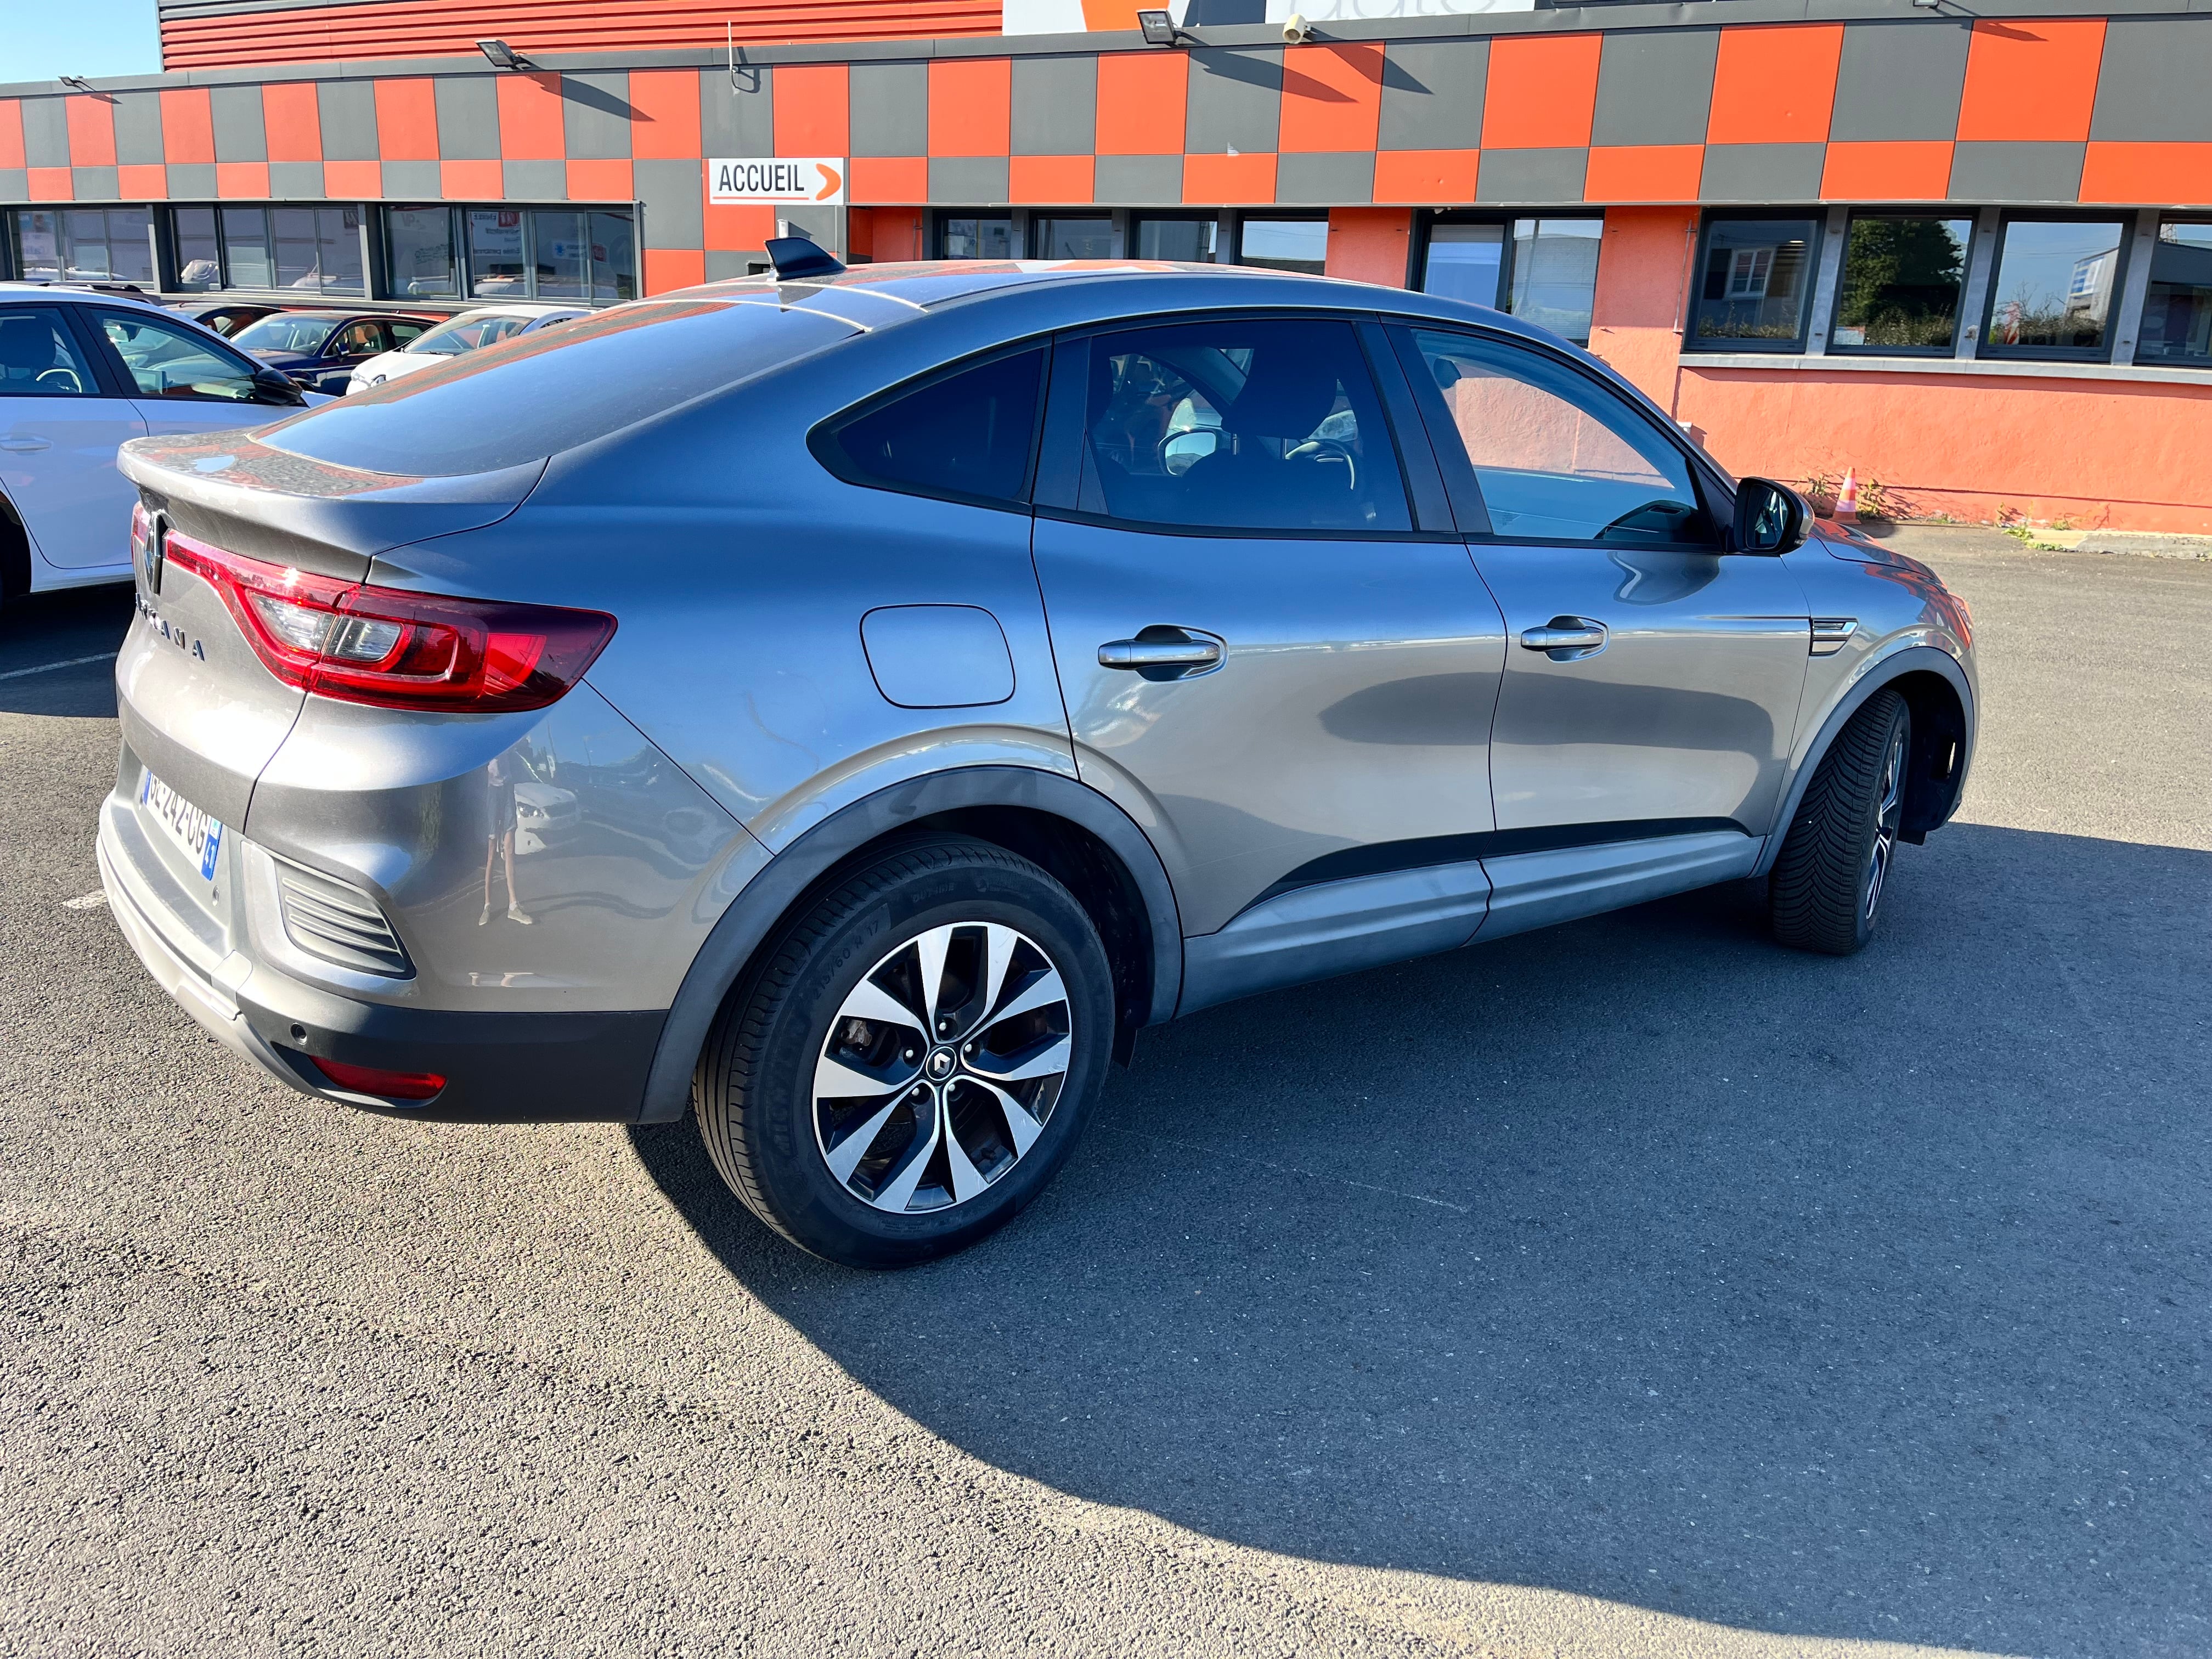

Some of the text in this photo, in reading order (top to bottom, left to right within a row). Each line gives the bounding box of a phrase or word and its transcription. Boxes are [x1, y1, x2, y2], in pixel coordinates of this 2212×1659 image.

[719, 164, 804, 192] ACCUEIL
[205, 841, 216, 869] 41
[866, 919, 878, 936] 17
